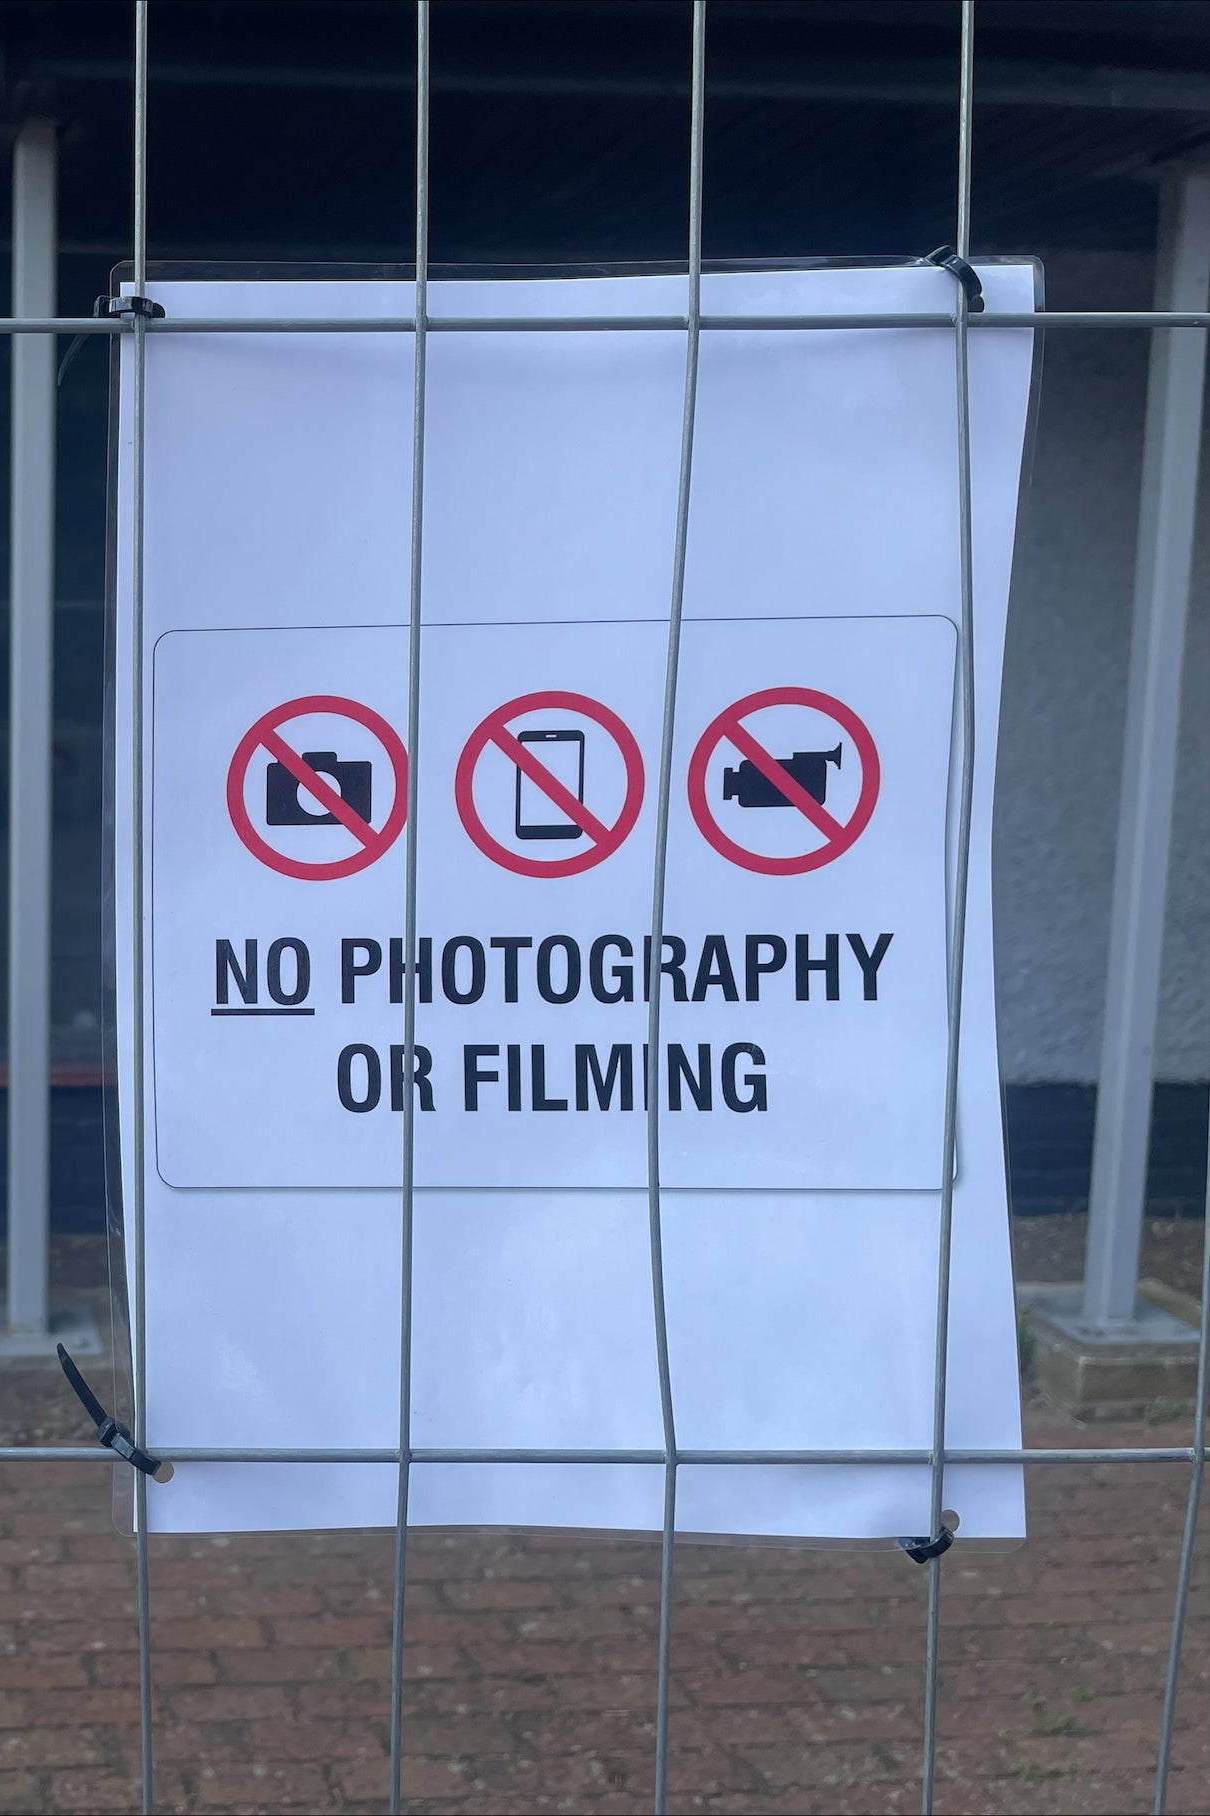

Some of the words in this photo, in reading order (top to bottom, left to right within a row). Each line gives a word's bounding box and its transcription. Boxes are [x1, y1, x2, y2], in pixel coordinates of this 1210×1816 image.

[215, 937, 311, 1004] NO
[340, 932, 894, 1005] PHOTOGRAPHY
[336, 1043, 436, 1113] OR
